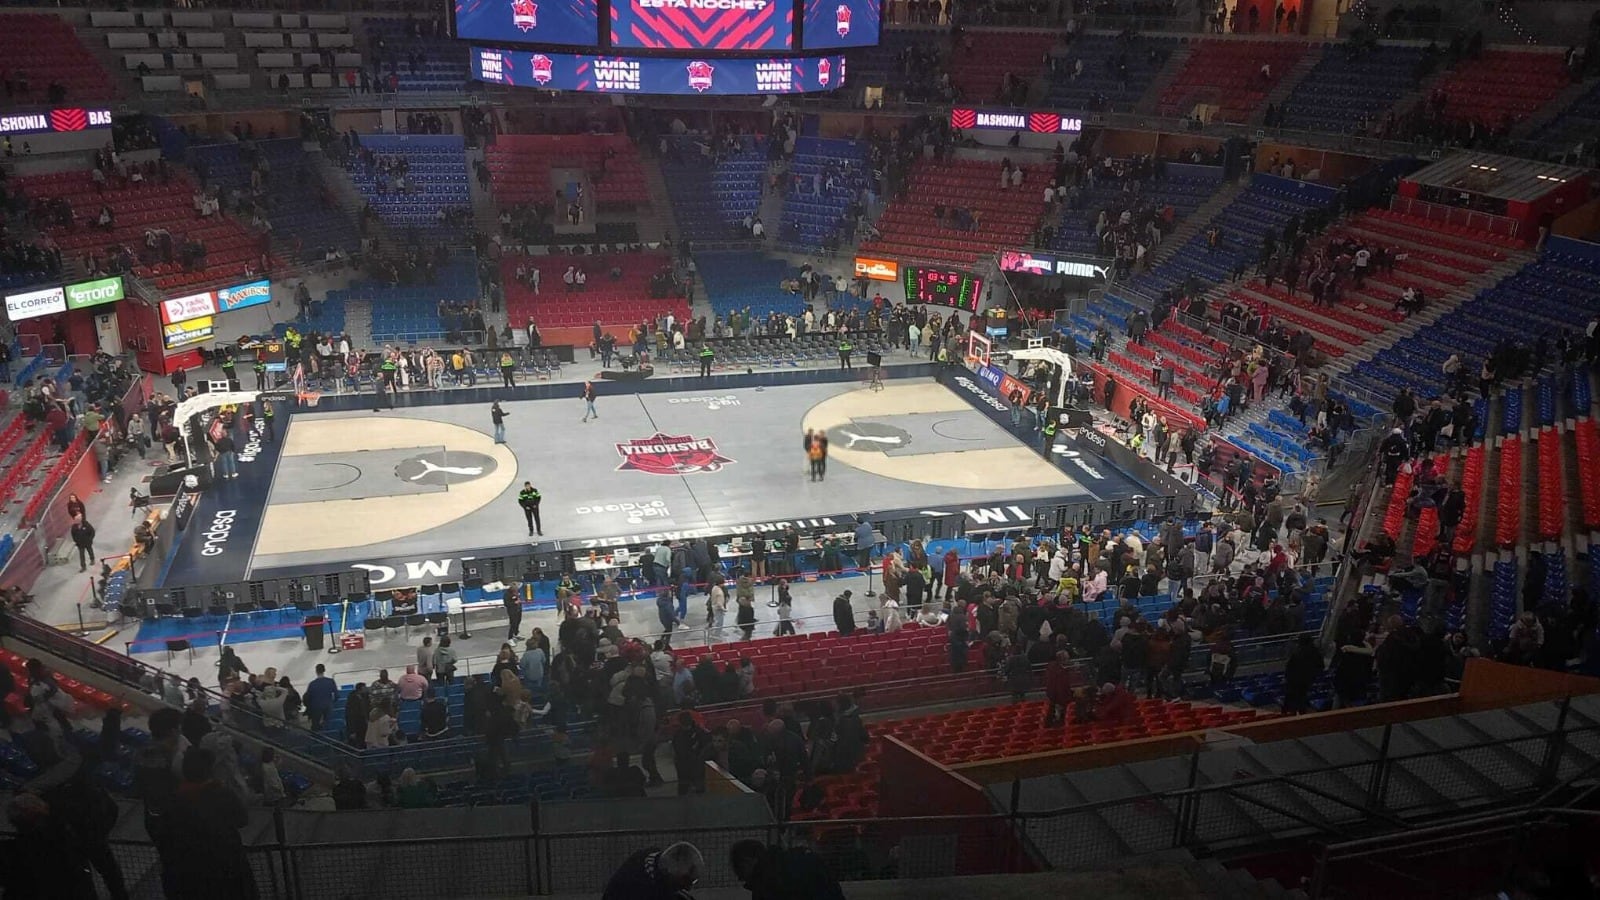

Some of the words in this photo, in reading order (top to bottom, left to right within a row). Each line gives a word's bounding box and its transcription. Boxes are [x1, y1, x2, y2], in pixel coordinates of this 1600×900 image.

[594, 69, 640, 81] WIN!
[756, 71, 791, 82] WIN!
[88, 111, 112, 125] BAS
[1061, 118, 1081, 131] BAS
[1056, 261, 1096, 277] PUMA
[8, 303, 20, 311] EL
[21, 295, 60, 308] CORREO
[1079, 426, 1106, 448] endesa
[201, 509, 238, 557] endesa
